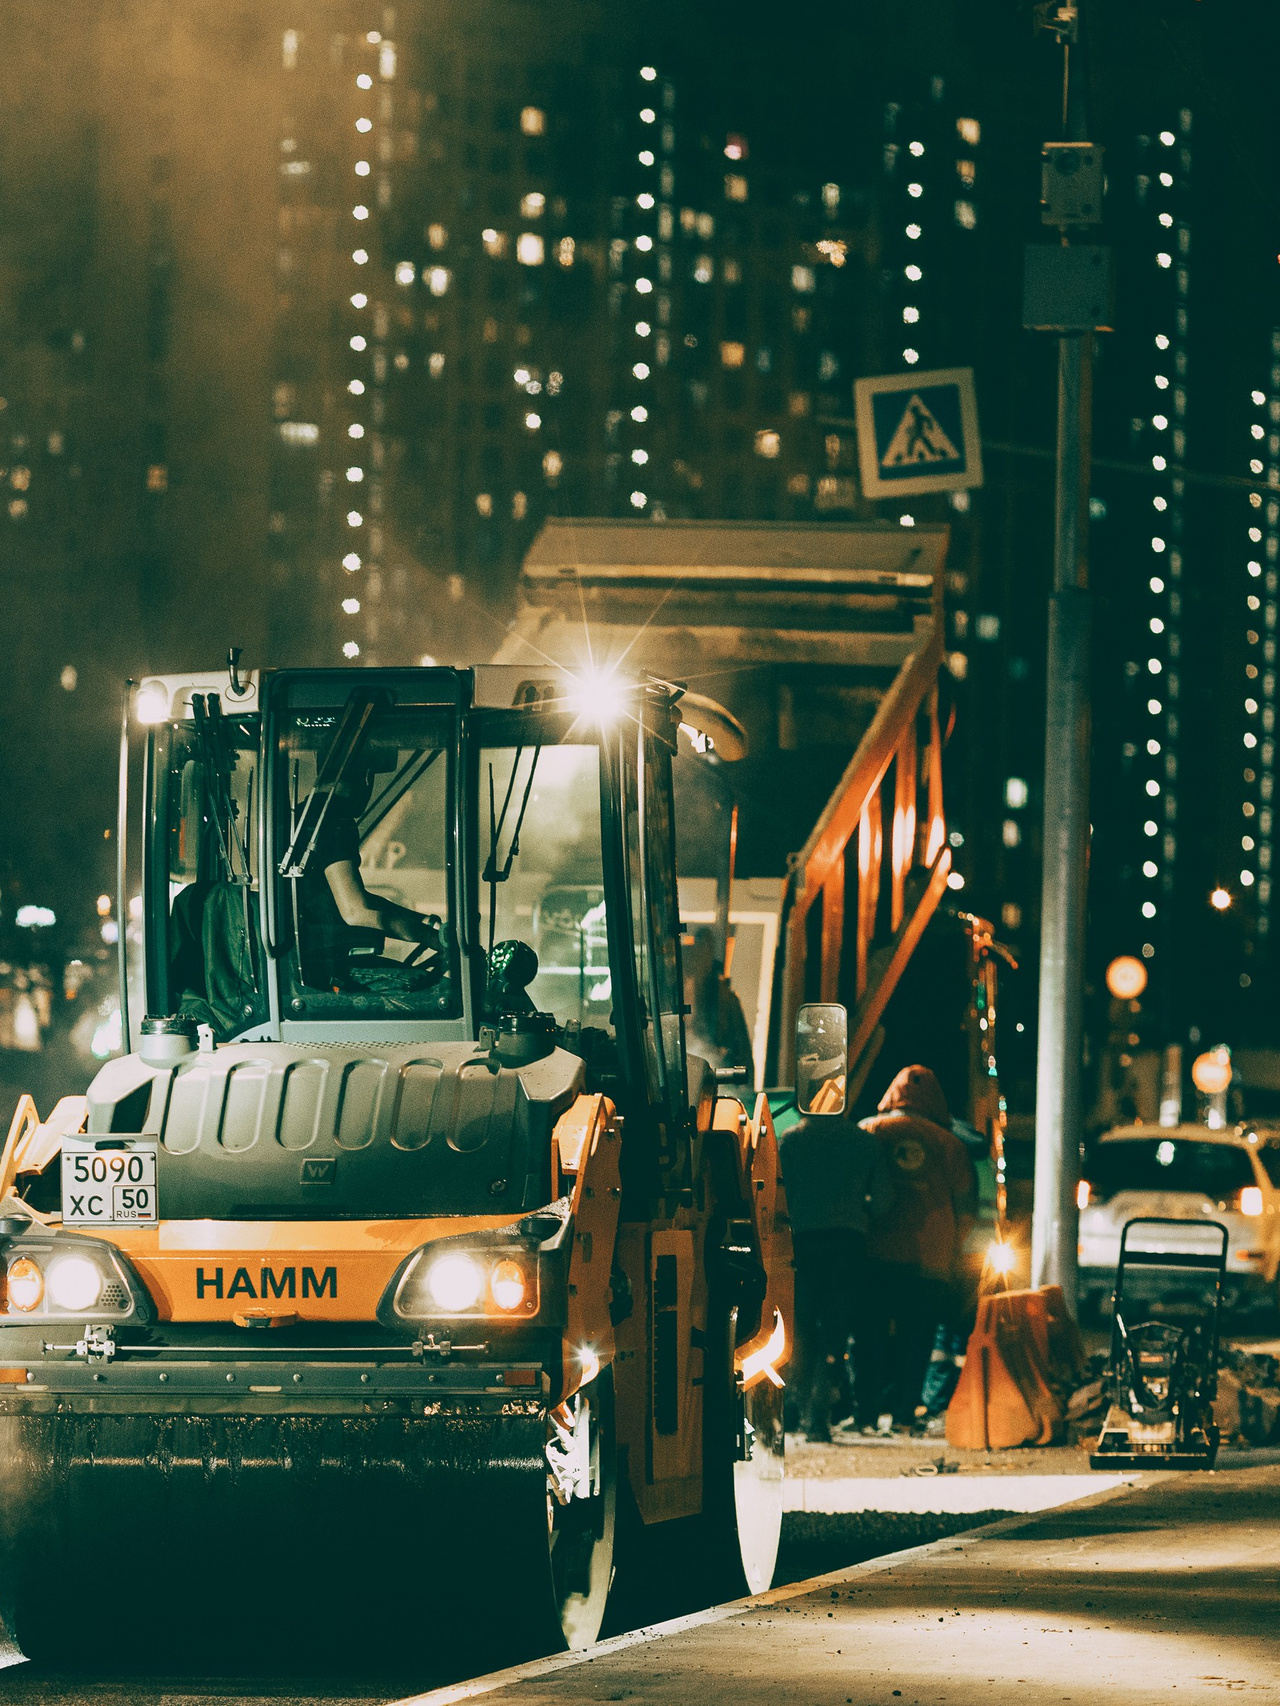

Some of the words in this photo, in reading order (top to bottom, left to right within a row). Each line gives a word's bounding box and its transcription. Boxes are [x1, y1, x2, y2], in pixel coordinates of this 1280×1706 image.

[74, 1155, 144, 1183] 5090
[122, 1188, 149, 1209] 50
[116, 1210, 137, 1219] RUS
[196, 1266, 338, 1299] HAMM
